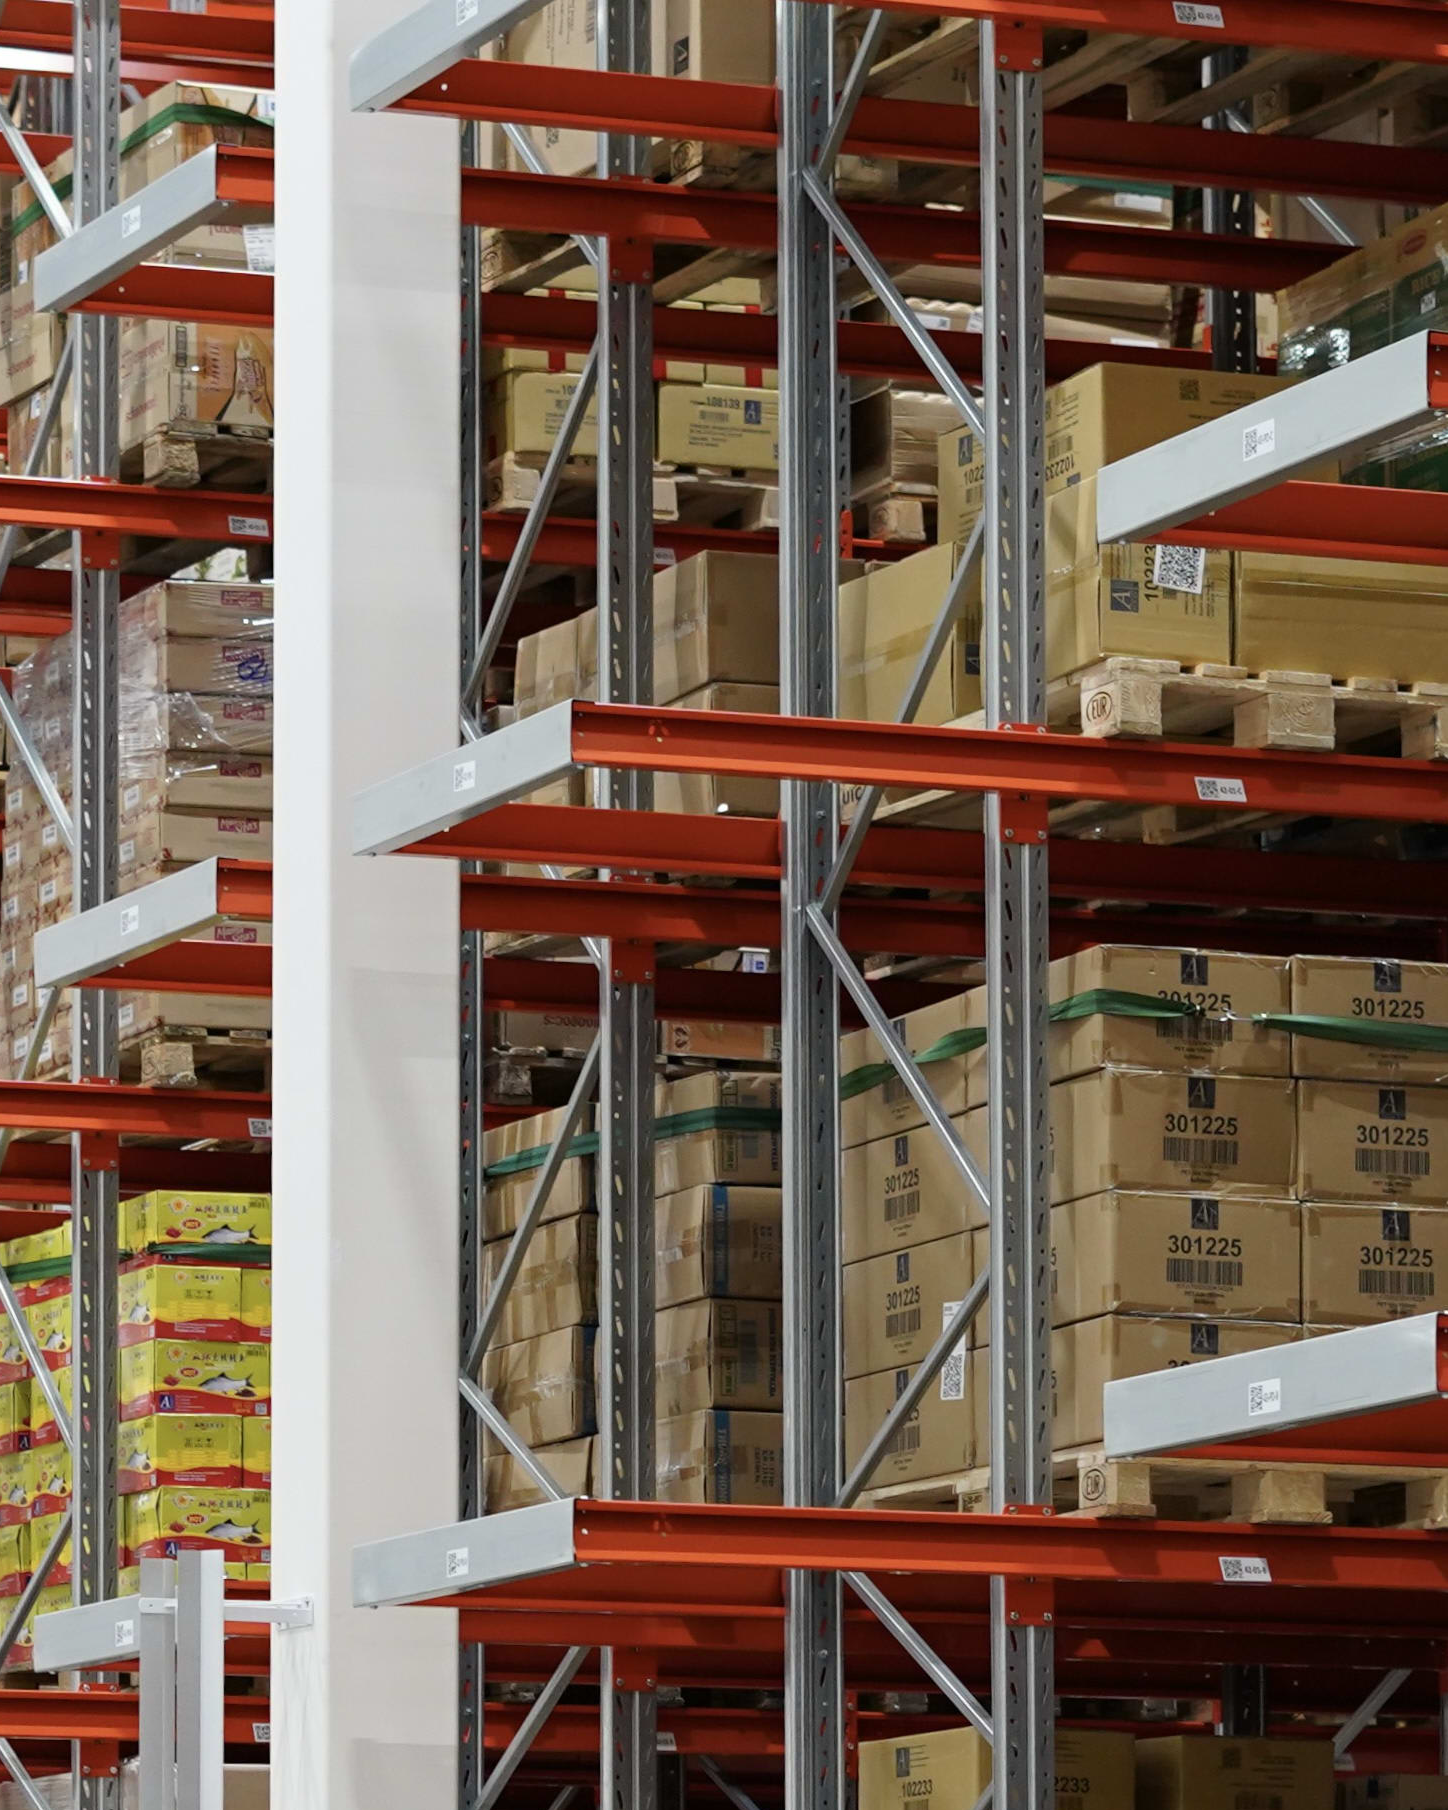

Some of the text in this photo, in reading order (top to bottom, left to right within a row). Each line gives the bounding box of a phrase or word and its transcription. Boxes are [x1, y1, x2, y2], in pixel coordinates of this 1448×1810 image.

[1045, 452, 1075, 482] 102233
[1352, 997, 1425, 1019] 301225
[1164, 1114, 1238, 1136] 301225
[1356, 1125, 1429, 1147] 301225
[883, 1169, 920, 1196] 301225
[1168, 1235, 1242, 1257] 301225
[1360, 1246, 1434, 1268] 301225
[886, 1287, 921, 1312] 301225
[900, 1778, 933, 1799] 102233
